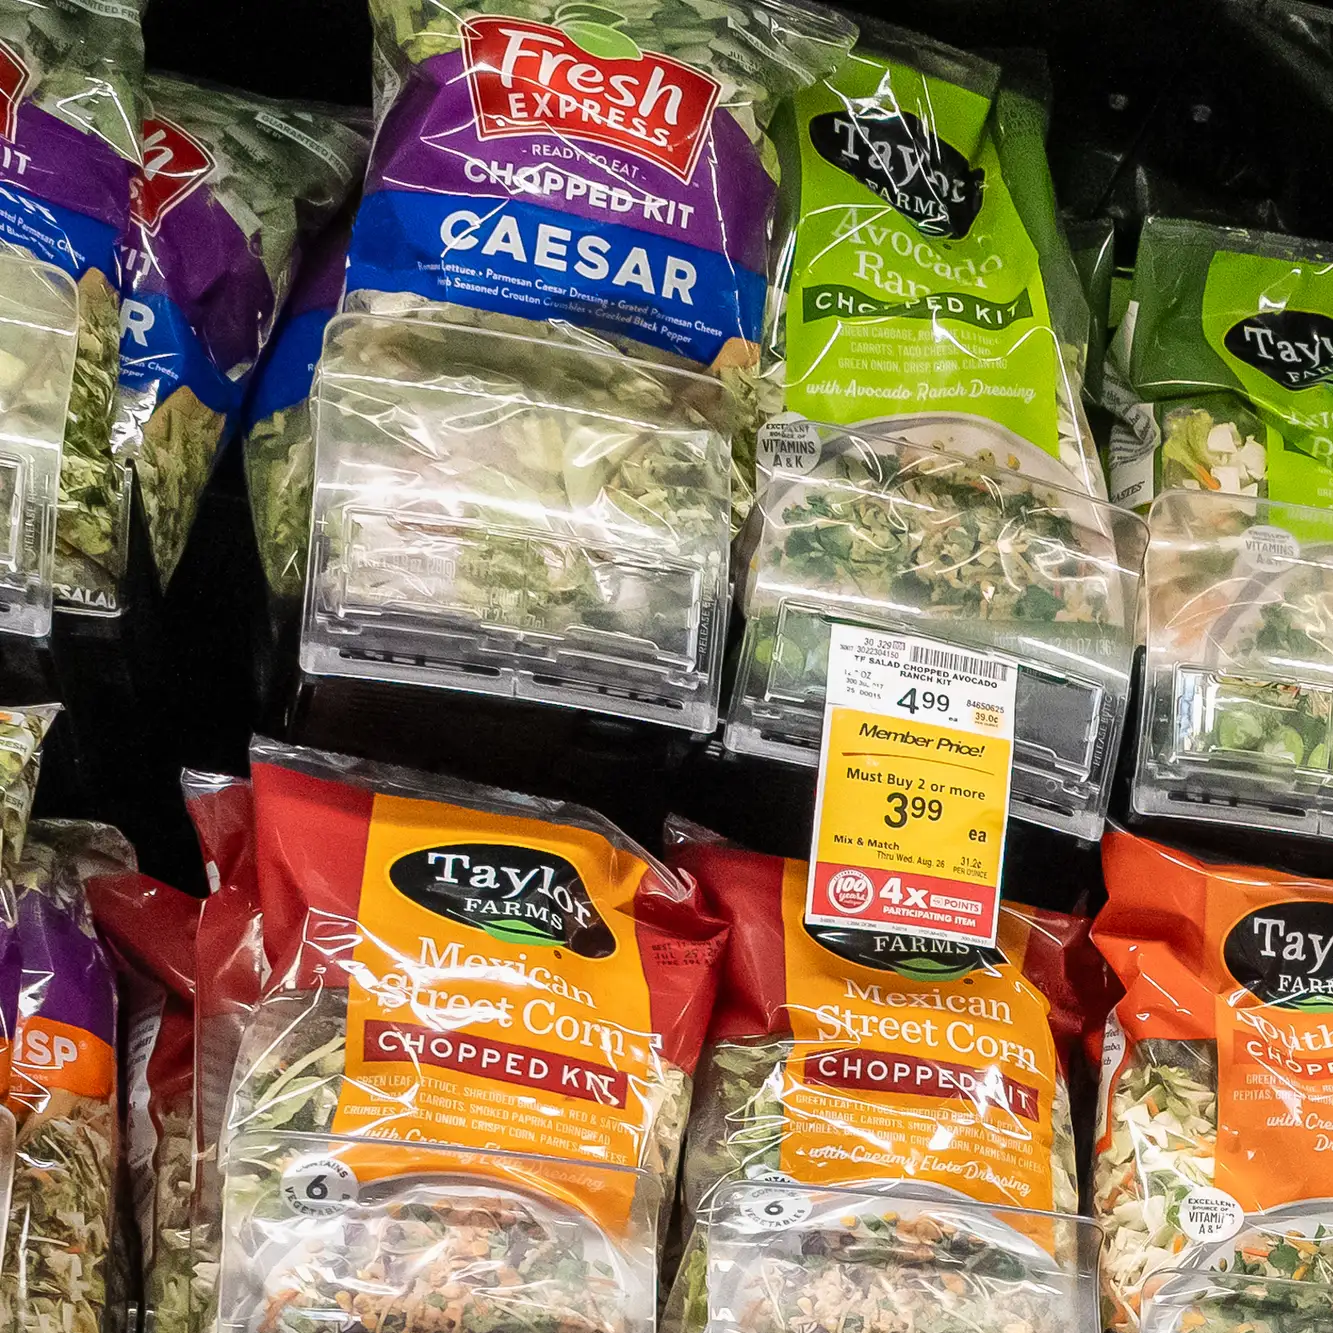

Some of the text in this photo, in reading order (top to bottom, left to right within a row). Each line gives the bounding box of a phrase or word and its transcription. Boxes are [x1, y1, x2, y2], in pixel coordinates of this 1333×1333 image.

[498, 31, 686, 129] Fresh
[509, 92, 670, 150] EXPRESS
[532, 144, 638, 178] READY TO EAT
[464, 159, 695, 229] CHOPPED KIT
[440, 210, 697, 305] CAESAR
[453, 277, 541, 305] Seasoned Crouton
[486, 269, 568, 295] Parmesan Caesar
[806, 378, 1036, 404] with Avocado Ranch Dressing
[761, 439, 816, 456] VITAMINS
[1245, 540, 1294, 557] VITAMINS
[854, 655, 998, 689] TF SALAD CHOPPED AVOCADO
[900, 669, 952, 687] RANCH KIT
[859, 722, 986, 758] Member Price!
[833, 834, 900, 852] Mix & Match
[877, 850, 945, 869] Thru Wed. Aug. 26
[428, 852, 592, 928] Taylor
[944, 899, 980, 913] POINTS
[463, 898, 563, 930] FARMS
[883, 905, 976, 928] PARTICIPATING ITEM
[874, 935, 971, 955] FARMS
[843, 977, 1013, 1025] Mexican
[522, 999, 625, 1056] Corn
[815, 1005, 1038, 1074] Street Corn
[378, 1030, 549, 1086] CHOPPED
[1267, 1113, 1302, 1128] with
[809, 1145, 1031, 1196] with Creamy Elote Dressing
[764, 1200, 779, 1216] 6
